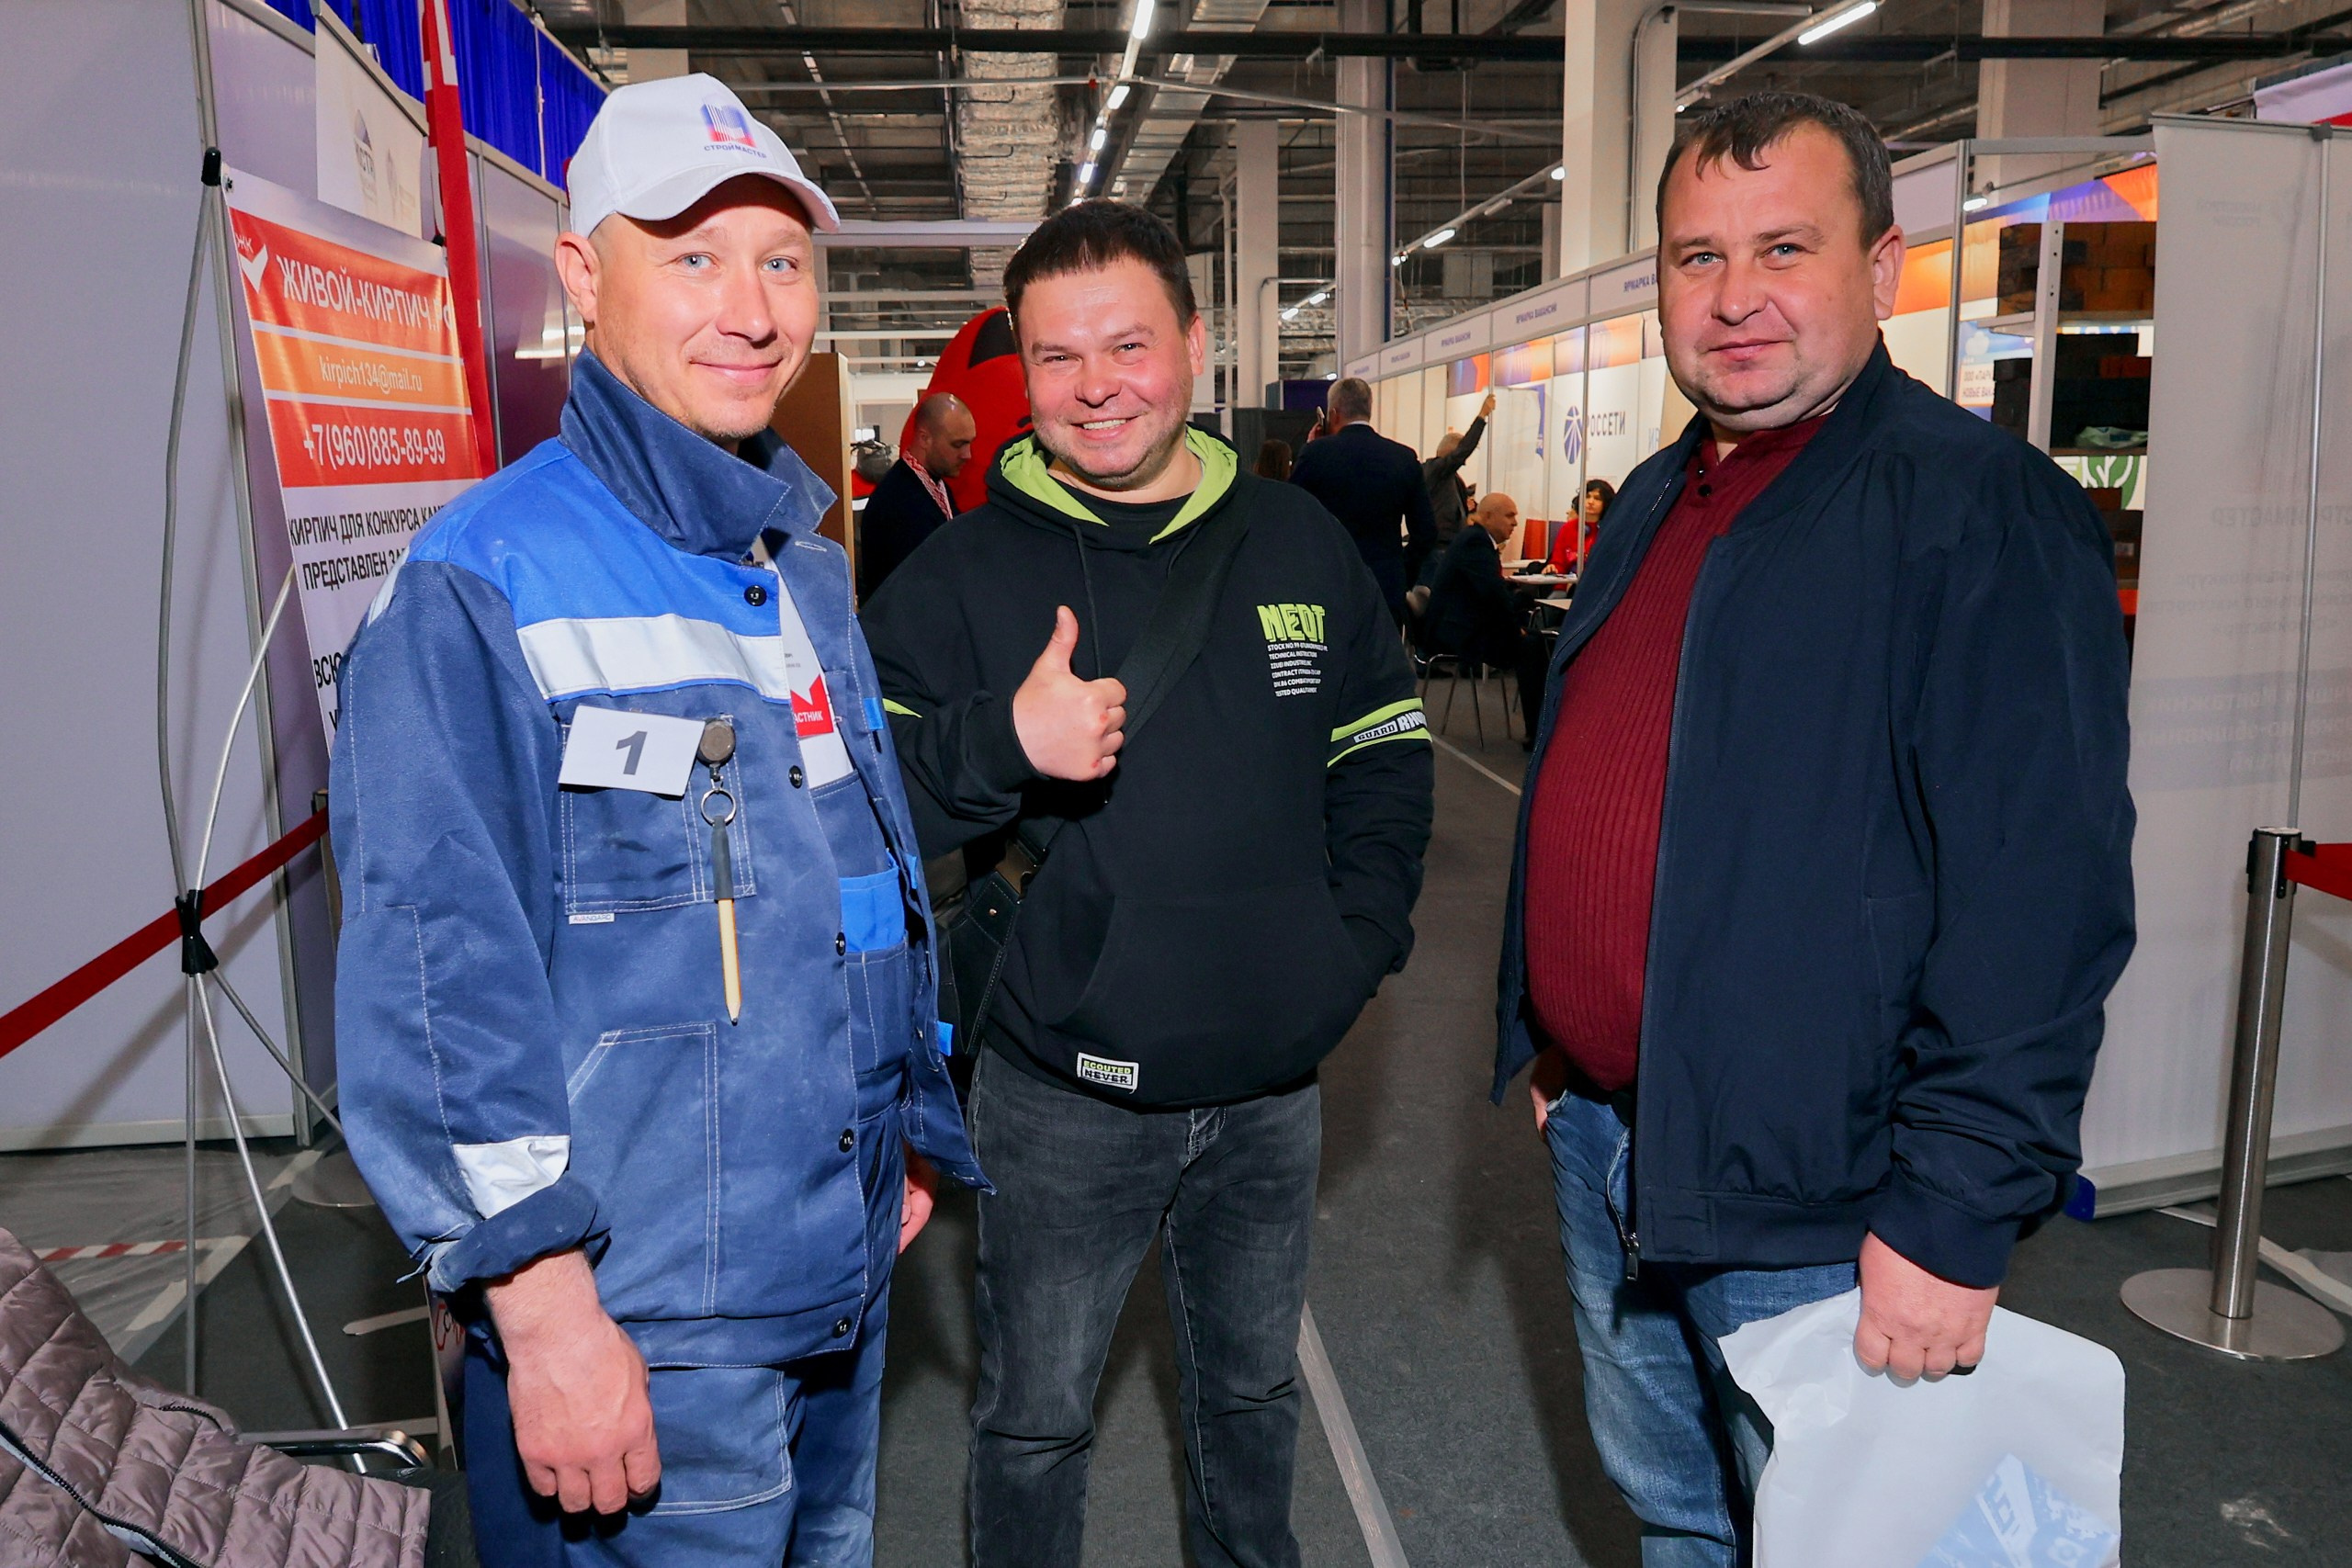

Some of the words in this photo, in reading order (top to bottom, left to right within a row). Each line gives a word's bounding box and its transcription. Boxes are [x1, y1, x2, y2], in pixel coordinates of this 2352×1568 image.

[704, 143, 766, 159] СТРОЙМАСТЕР
[319, 355, 423, 395] kirpich134@mail.ru
[303, 423, 446, 470] +7(960)885-89-99
[288, 514, 337, 546] КИРПИЧ
[341, 513, 364, 545] ДЛЯ
[365, 507, 421, 536] КОНКУРСА
[421, 505, 445, 525] КА
[302, 550, 389, 591] ПРЕДСТАВЛЕН
[1272, 669, 1297, 679] CONTRACT
[1358, 724, 1396, 740] GUARD
[616, 730, 648, 775] 1
[1085, 1069, 1128, 1084] NEVER
